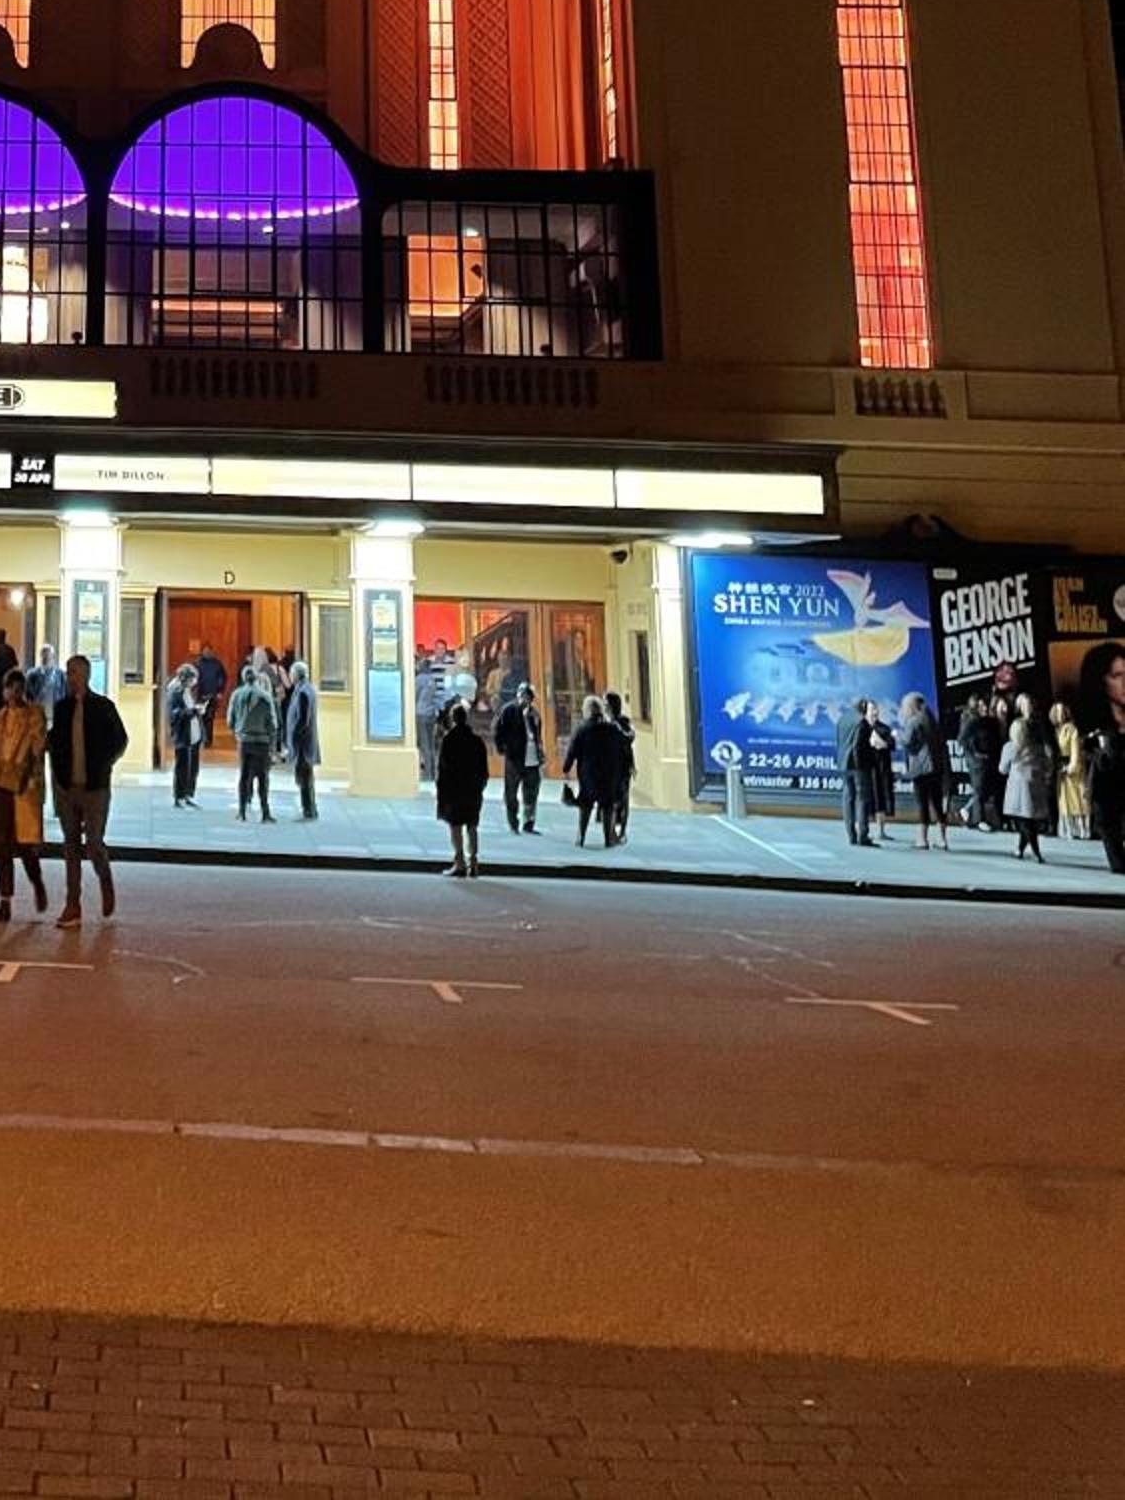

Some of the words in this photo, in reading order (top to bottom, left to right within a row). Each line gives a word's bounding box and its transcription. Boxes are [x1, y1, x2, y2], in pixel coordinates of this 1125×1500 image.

[20, 458, 46, 472] SAT
[29, 473, 52, 485] APR
[224, 571, 236, 585] D
[714, 592, 781, 615] SHEN
[787, 597, 840, 617] YUN
[940, 572, 1033, 634] GEORGE
[944, 617, 1036, 679] BENSON
[748, 753, 792, 769] 22-26
[795, 755, 837, 770] APRIL
